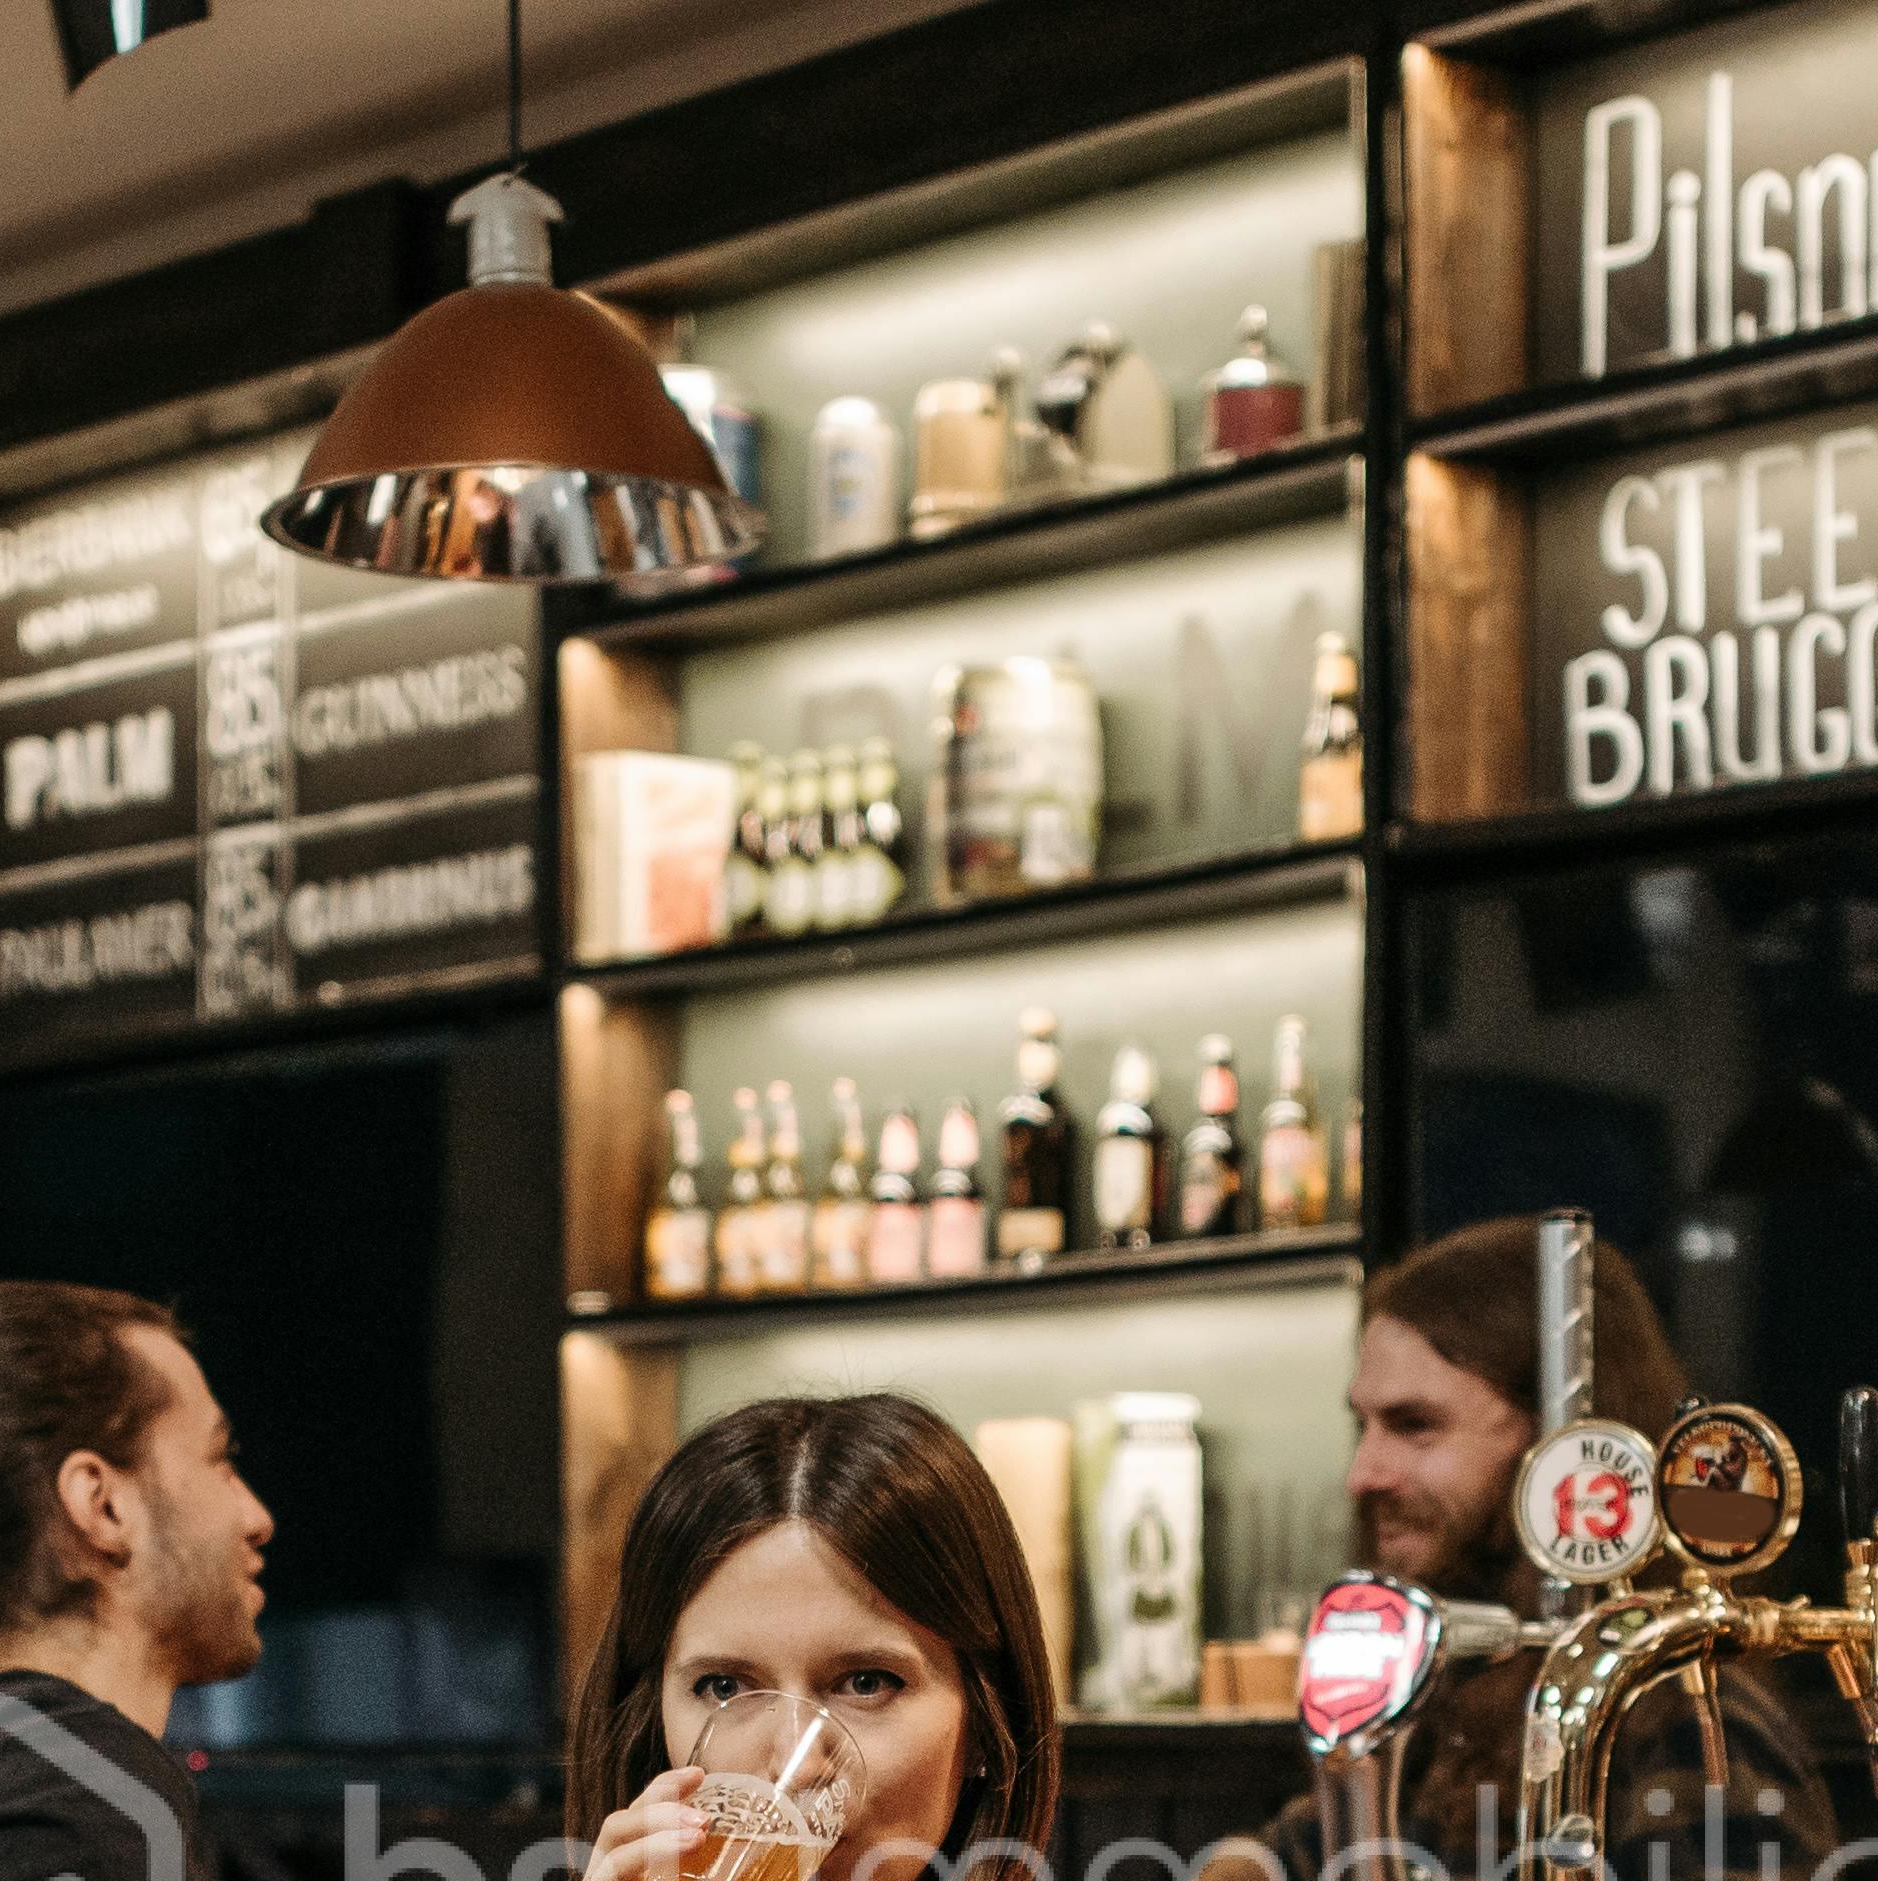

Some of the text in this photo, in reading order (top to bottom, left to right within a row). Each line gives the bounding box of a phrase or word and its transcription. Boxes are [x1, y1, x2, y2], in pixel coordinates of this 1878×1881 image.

[4, 706, 175, 830] PALM
[1580, 1439, 1649, 1498] HOUSE
[1553, 1470, 1633, 1539] 13
[1550, 1535, 1632, 1566] LAGER
